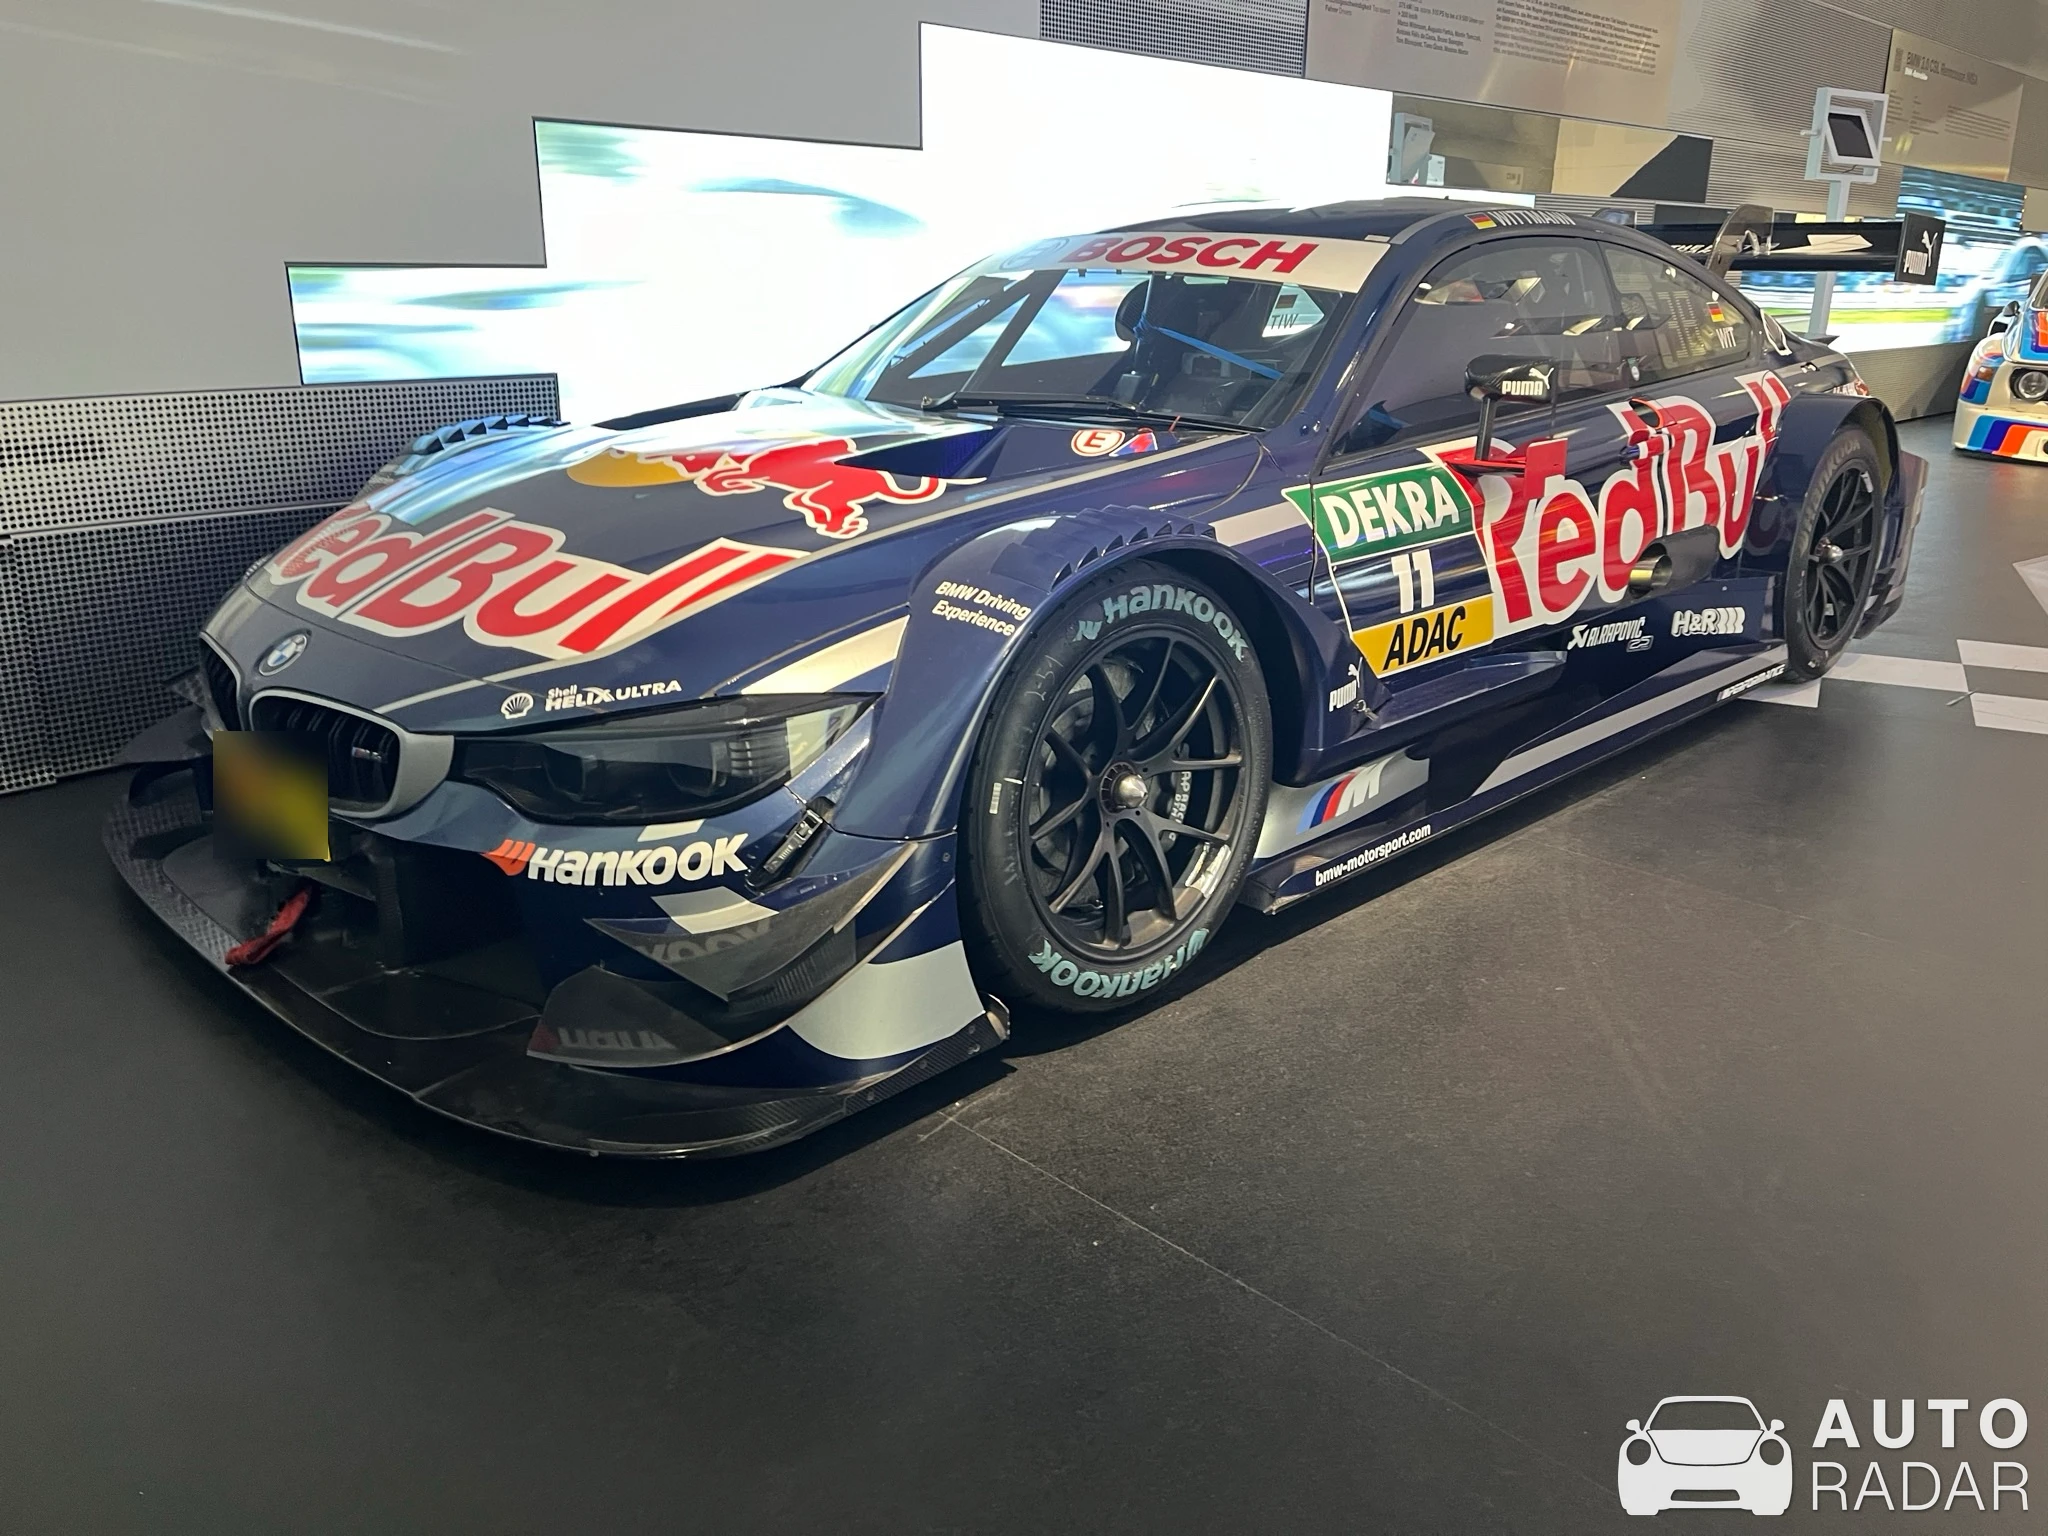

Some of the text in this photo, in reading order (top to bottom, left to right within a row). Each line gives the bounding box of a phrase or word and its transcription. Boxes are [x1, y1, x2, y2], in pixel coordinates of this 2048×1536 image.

[1487, 209, 1577, 227] WITTMANN
[1059, 237, 1319, 274] BOSCH
[1715, 326, 1737, 349] WIT
[1501, 380, 1544, 396] PUMA
[1319, 475, 1460, 549] DEKRA
[1391, 549, 1436, 614] 11
[932, 599, 1016, 636] Experience
[935, 581, 1032, 620] BMW Driving
[1382, 605, 1466, 671] ADAC
[1671, 608, 1721, 637] H&R
[545, 680, 682, 712] HELIX ULTRA
[548, 684, 578, 699] Shell
[1329, 680, 1357, 712] PUMA
[1315, 823, 1431, 886] bmw-motorsport.com
